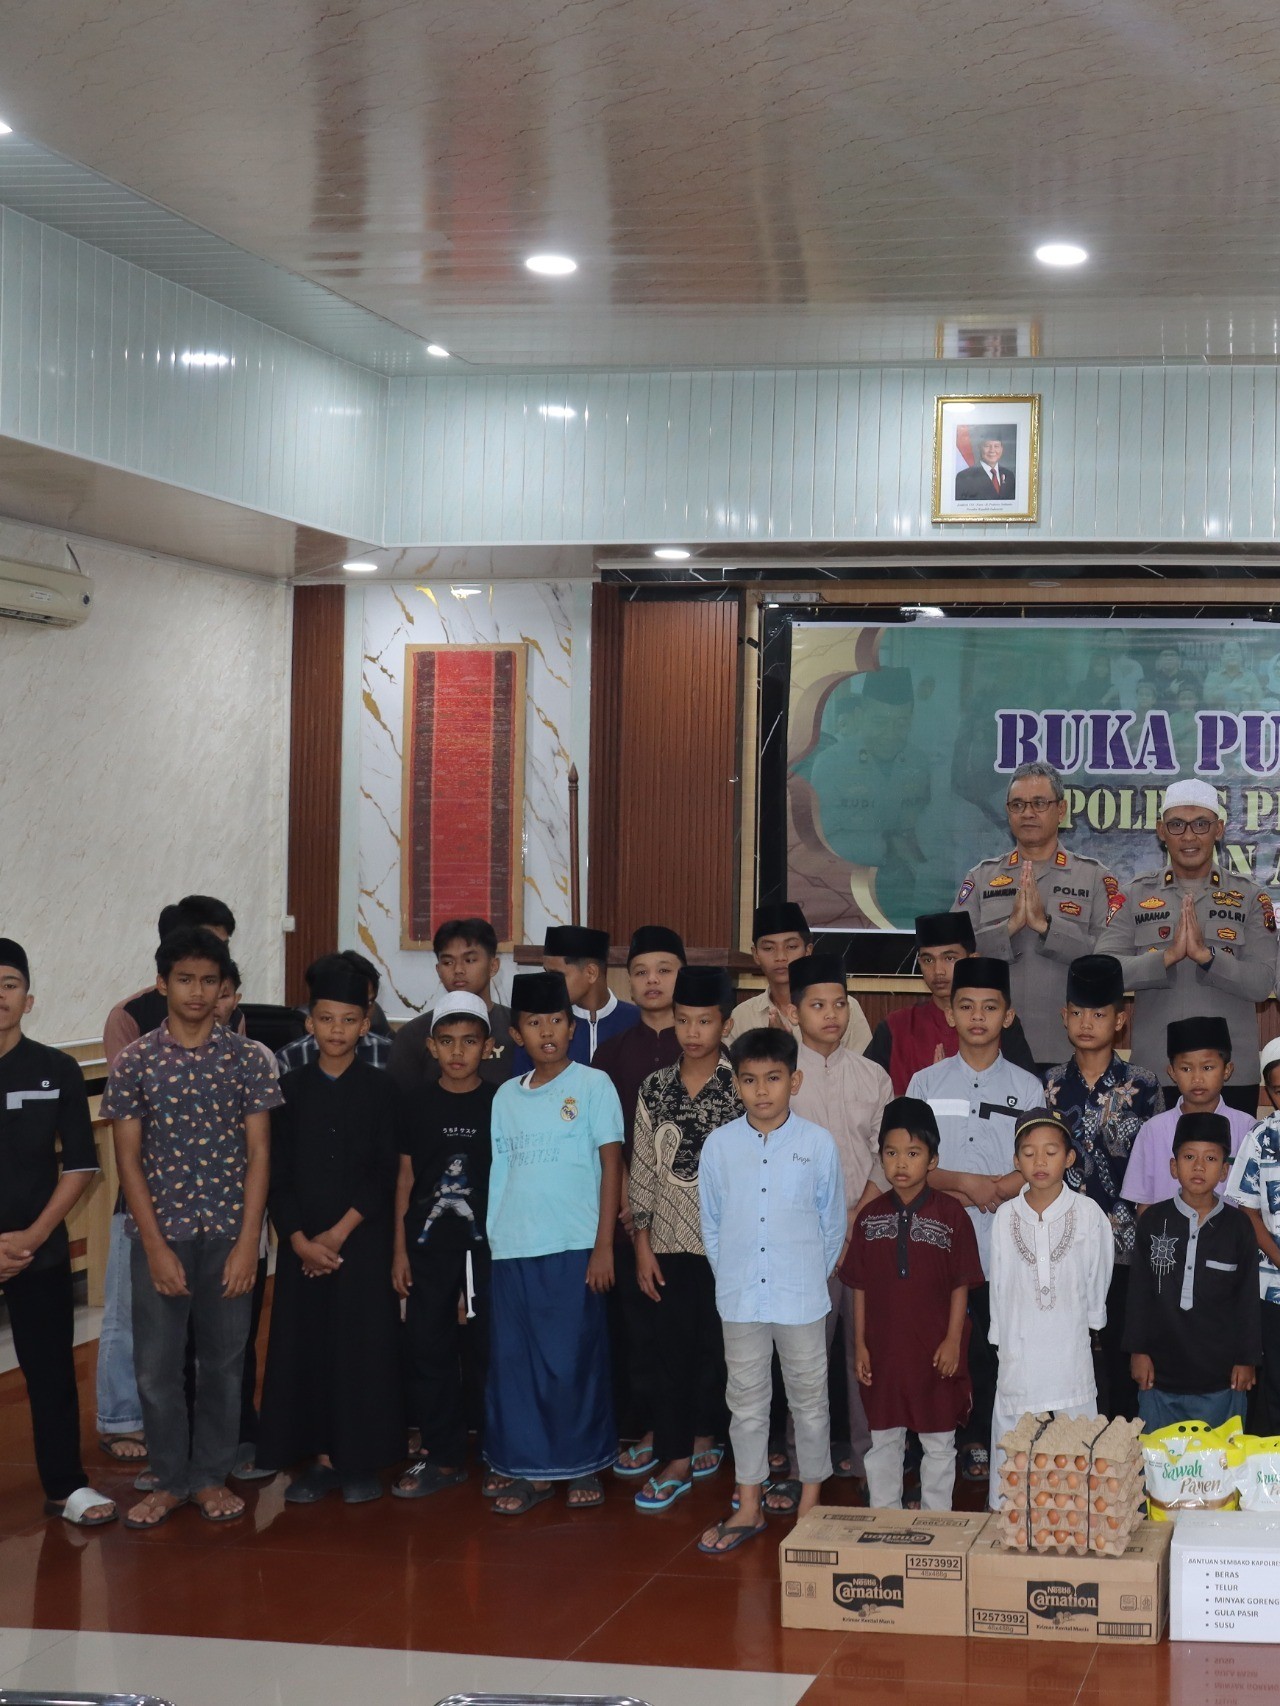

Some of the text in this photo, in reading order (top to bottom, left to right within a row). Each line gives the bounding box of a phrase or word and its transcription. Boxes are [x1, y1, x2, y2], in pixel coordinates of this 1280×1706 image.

[997, 712, 1177, 771] BUKA
[1053, 885, 1089, 897] POLRI
[1135, 911, 1170, 925] HARAHAP
[1209, 910, 1246, 923] POLRI
[1162, 1459, 1203, 1481] Sawah
[1180, 1477, 1222, 1495] Panen
[909, 1557, 959, 1569] 12573992
[836, 1581, 902, 1603] Carnation
[1029, 1589, 1097, 1611] Carnation
[976, 1612, 1025, 1624] 12573992
[1214, 1609, 1235, 1617] GULA
